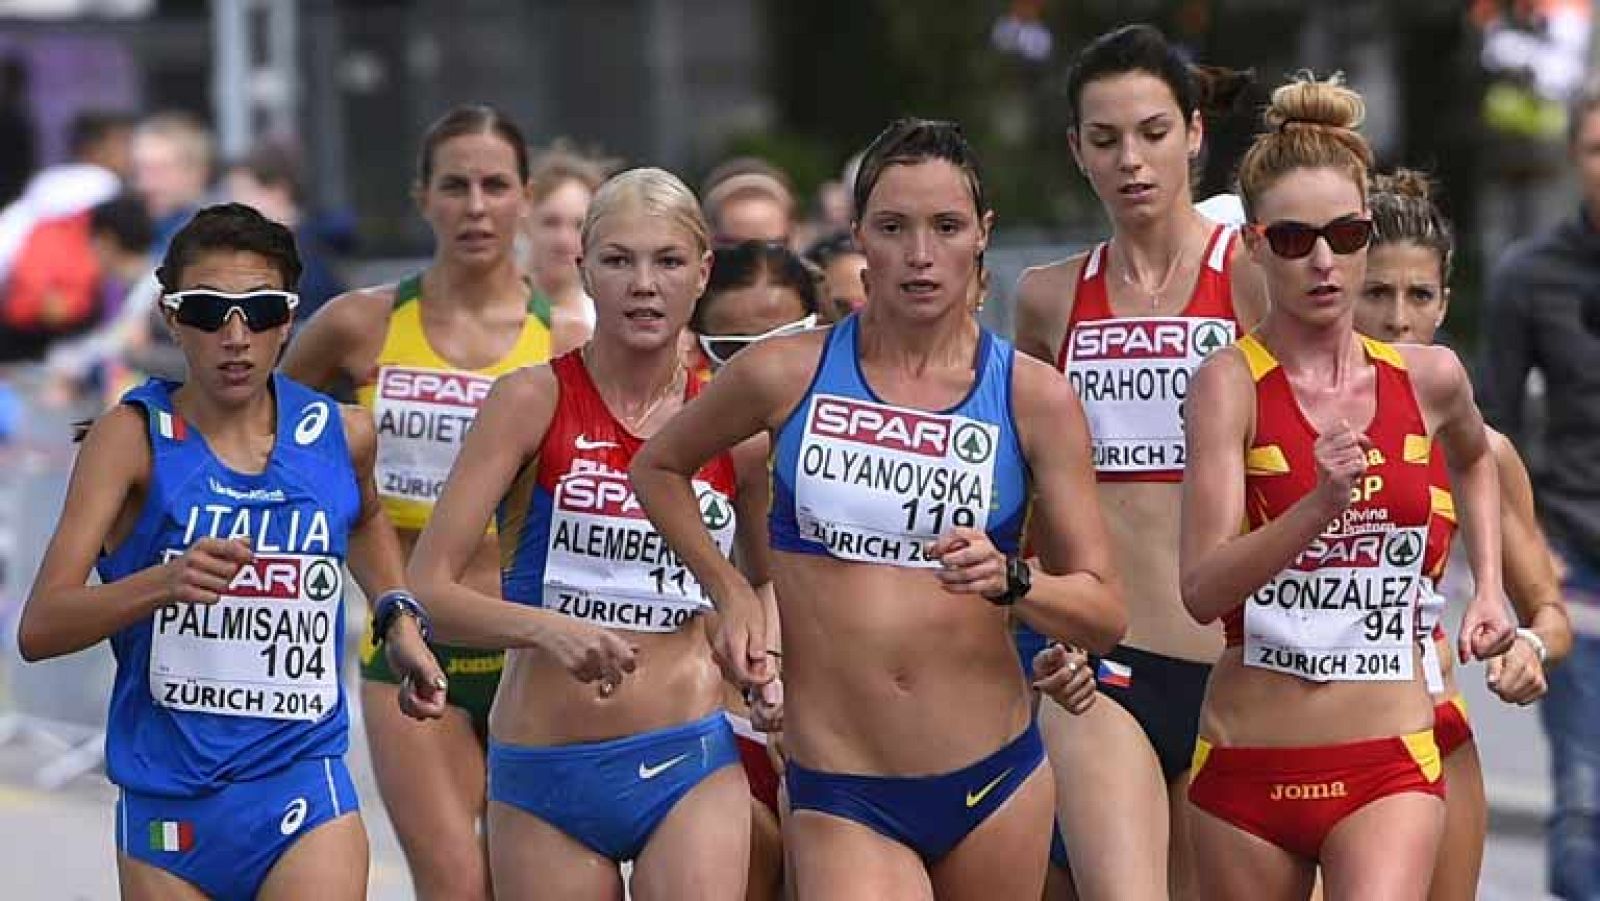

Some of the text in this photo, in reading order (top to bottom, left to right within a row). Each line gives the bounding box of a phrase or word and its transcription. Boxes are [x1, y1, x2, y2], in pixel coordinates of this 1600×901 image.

[1075, 325, 1187, 357] SPAR
[815, 402, 947, 452] SPAR
[803, 443, 983, 509] OLYANOVSKA
[563, 477, 642, 512] SPA
[183, 504, 330, 551] ITALIA
[1253, 570, 1413, 610] GONZÁLEZ
[159, 603, 329, 645] PALMISANO
[558, 590, 653, 627] ZÜRICH
[1364, 610, 1404, 641] 94
[261, 644, 326, 680] 104
[1260, 646, 1401, 676] ZÜRICH 2014
[163, 679, 323, 714] ZÜRICH 2014
